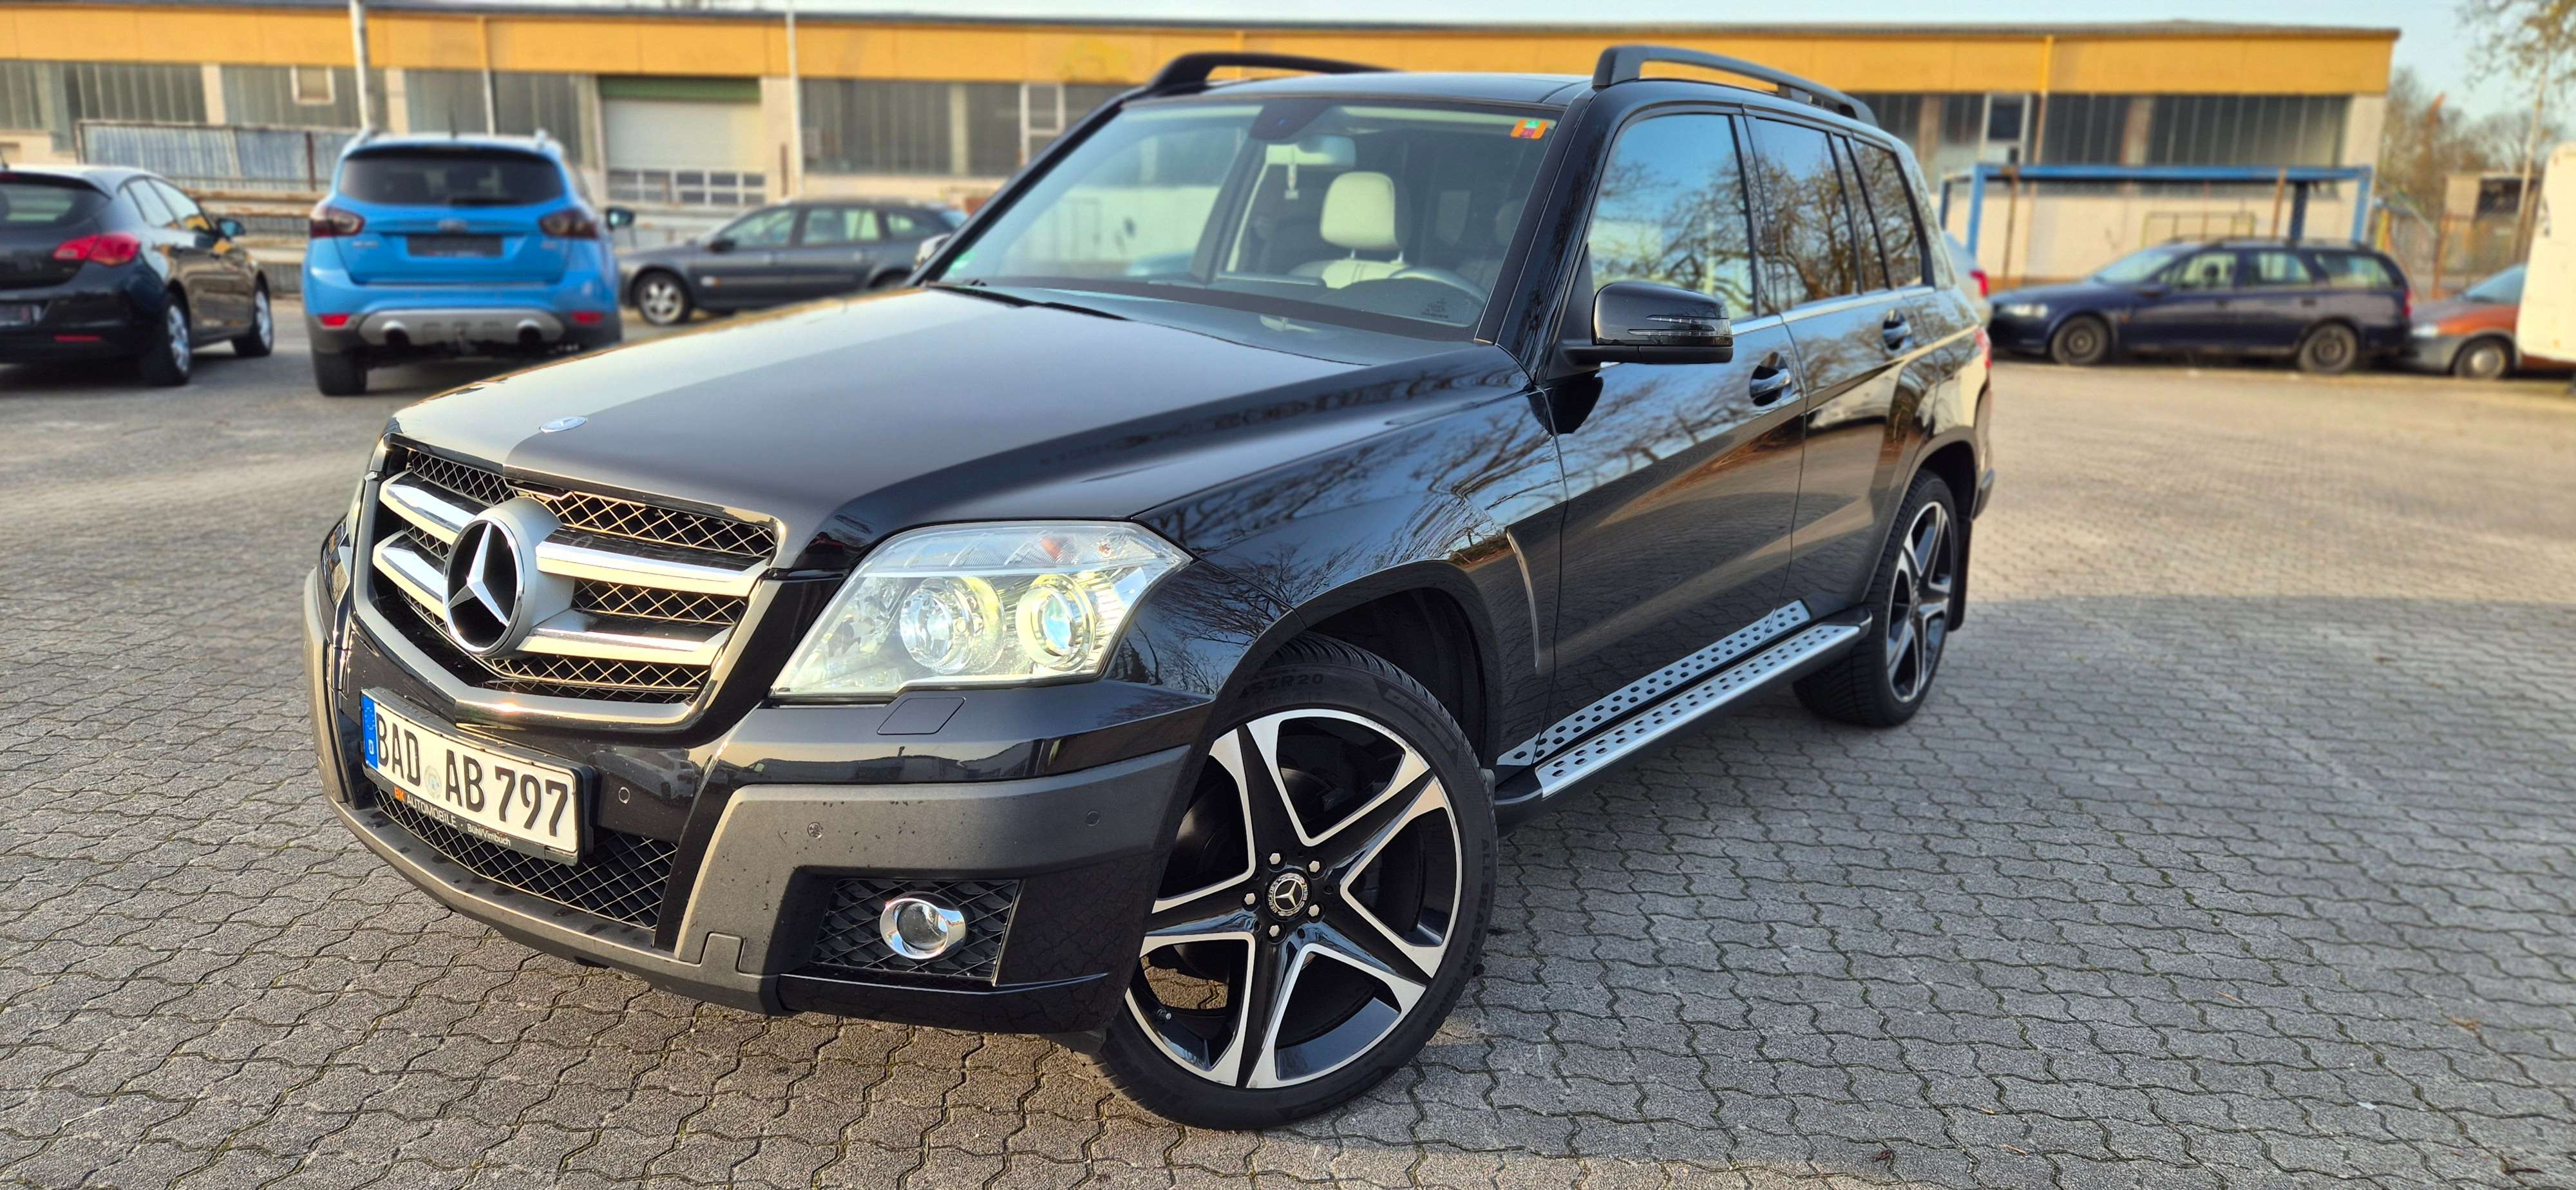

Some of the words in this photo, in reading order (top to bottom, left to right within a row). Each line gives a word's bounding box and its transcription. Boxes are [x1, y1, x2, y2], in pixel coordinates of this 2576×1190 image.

[368, 739, 374, 755] D
[376, 712, 421, 787] BAD
[445, 748, 485, 813] AB
[495, 765, 568, 838] 797
[394, 786, 406, 802] BK
[406, 794, 458, 829] AUTOMOBILE
[1481, 838, 1491, 876] ALL
[1268, 881, 1279, 913] MERCEDES
[1460, 882, 1491, 973] SEASON
